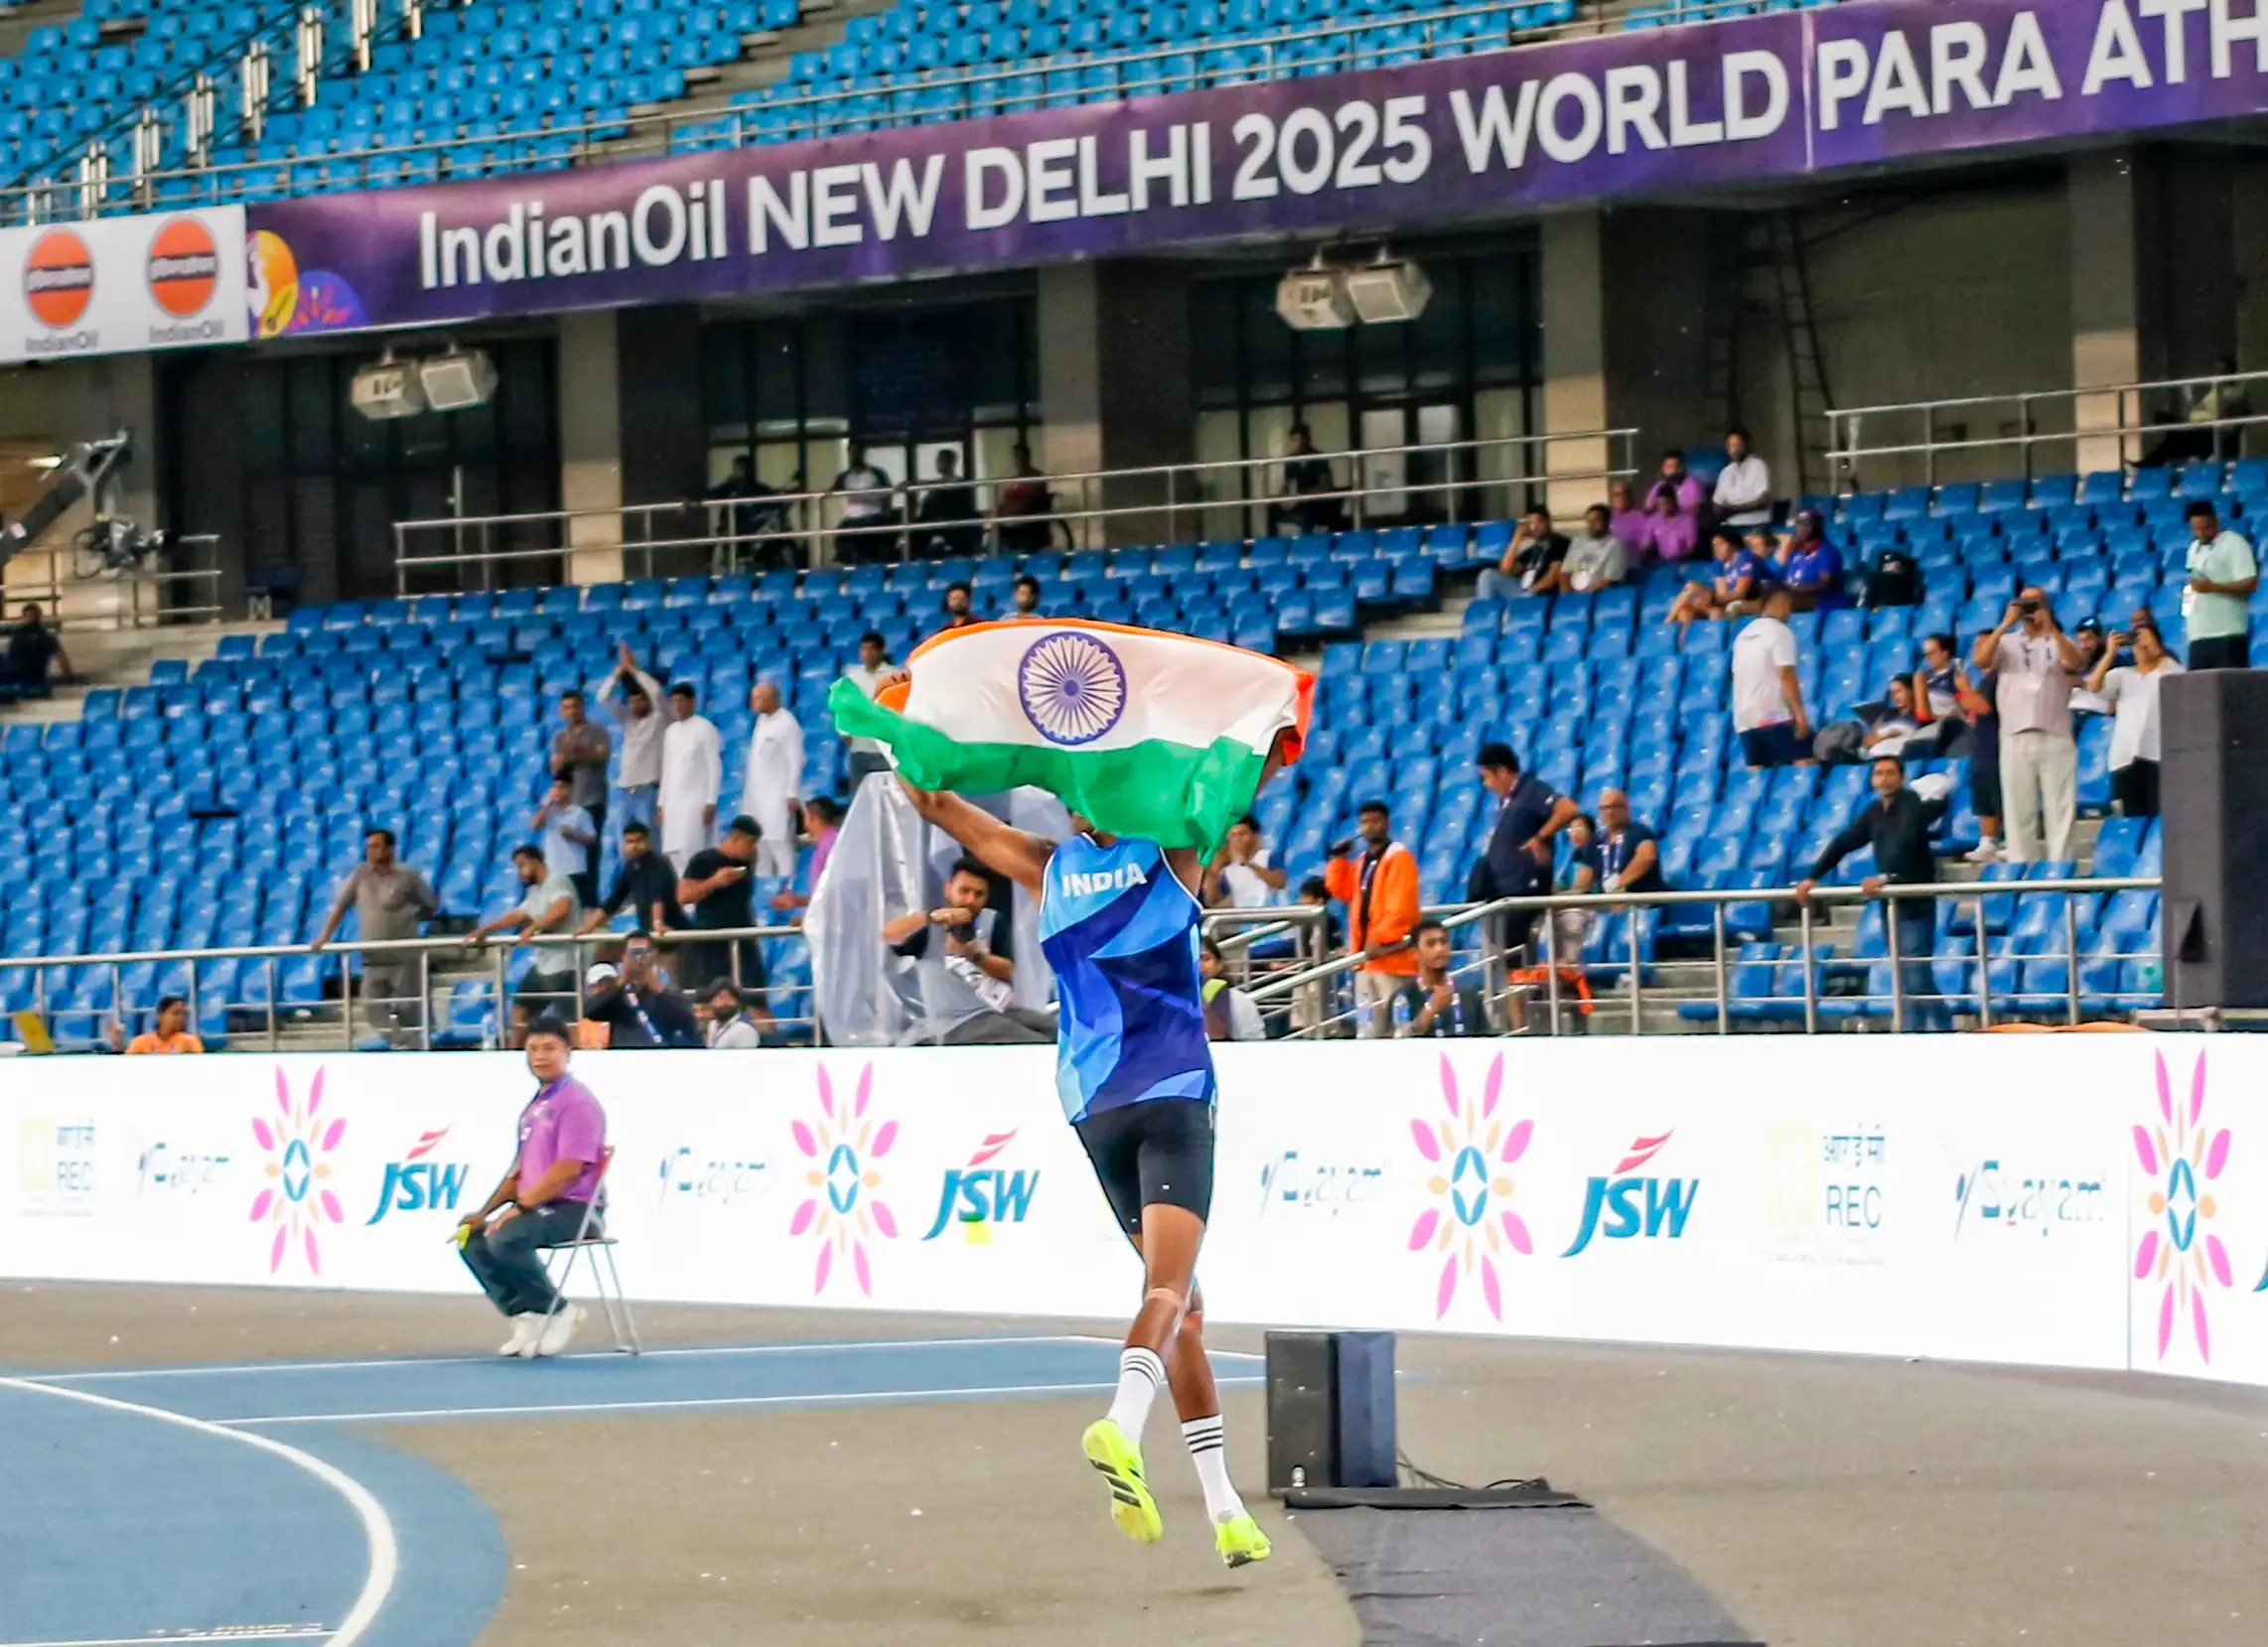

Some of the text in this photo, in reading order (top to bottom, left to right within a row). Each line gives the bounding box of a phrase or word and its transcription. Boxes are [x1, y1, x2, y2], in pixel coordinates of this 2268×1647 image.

[420, 178, 727, 289] IndianOil
[747, 153, 945, 255] NEW
[964, 121, 1212, 231] DELHI
[1232, 94, 1433, 201] 2025
[1449, 50, 1789, 175] WORLD
[1817, 11, 2063, 131] PARA
[1062, 862, 1148, 897] INDIA
[364, 1161, 470, 1226] JSW
[921, 1168, 1041, 1241] JSW
[1559, 1175, 1699, 1258] JSW
[1825, 1184, 1882, 1229] REC
